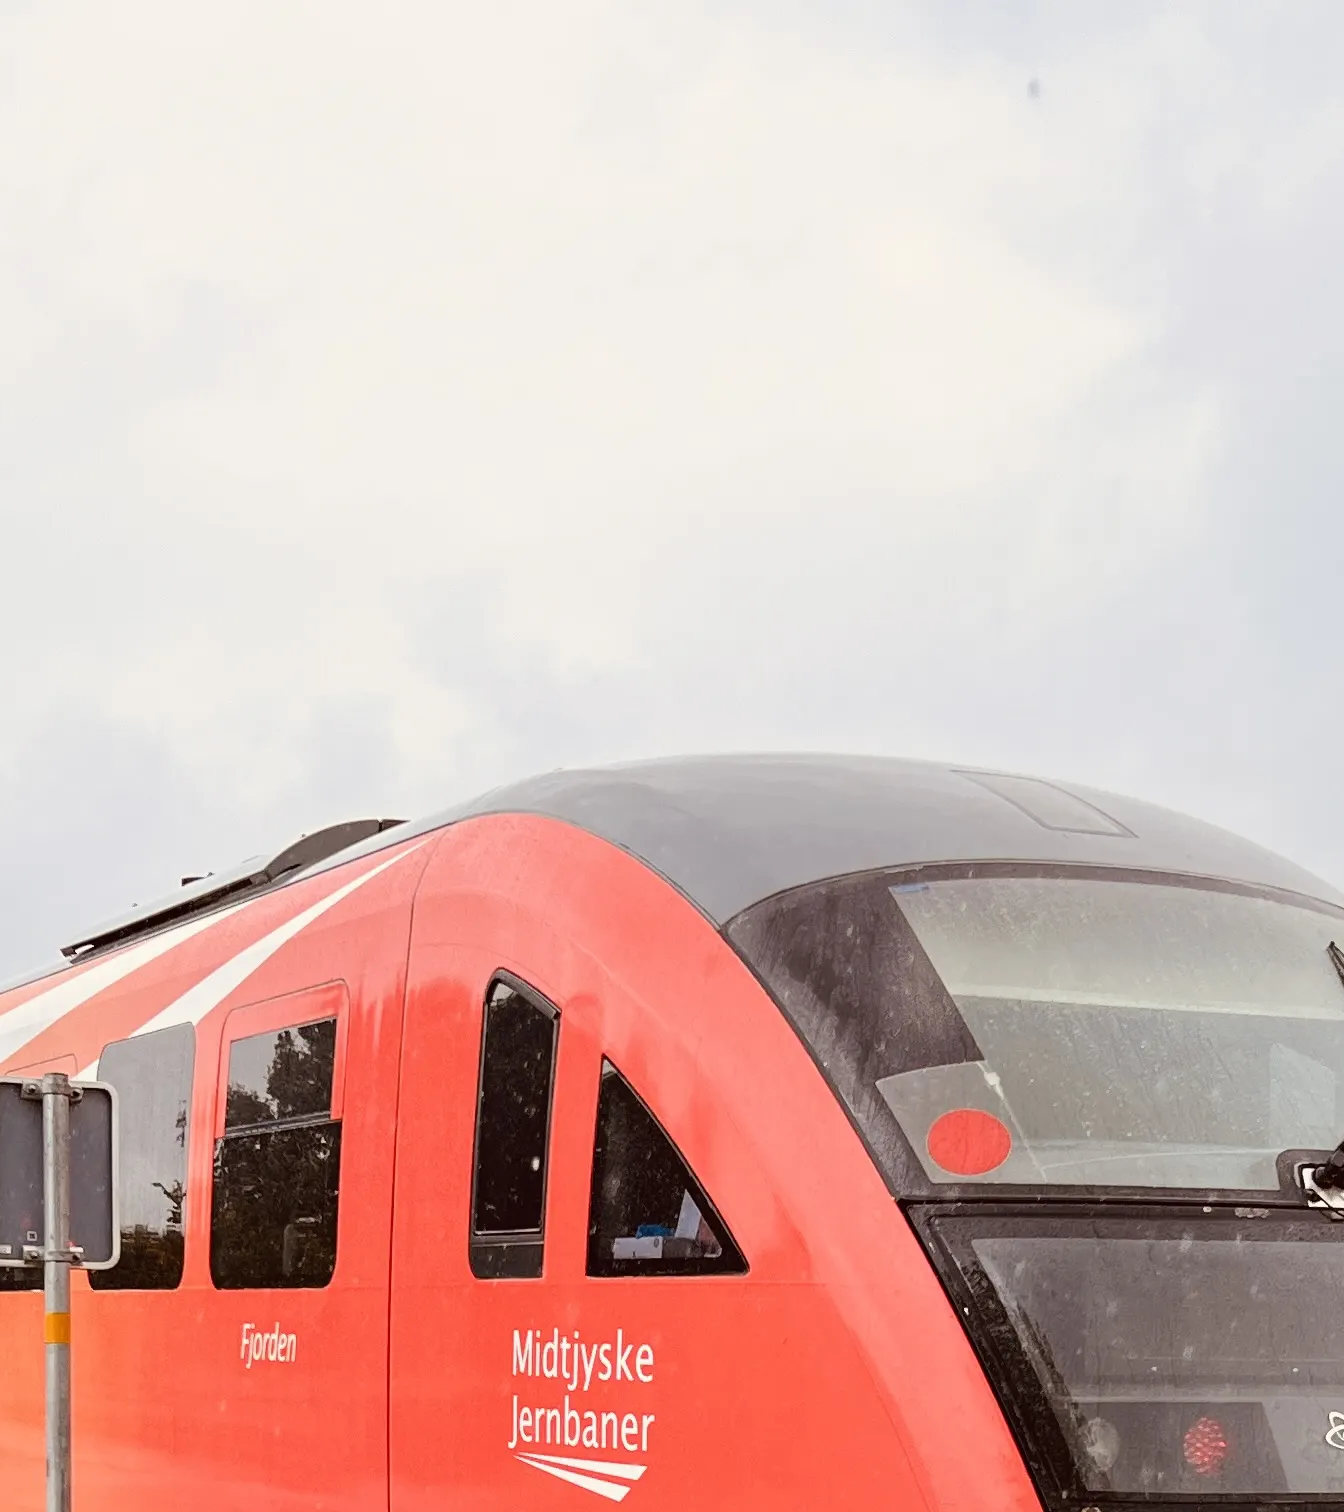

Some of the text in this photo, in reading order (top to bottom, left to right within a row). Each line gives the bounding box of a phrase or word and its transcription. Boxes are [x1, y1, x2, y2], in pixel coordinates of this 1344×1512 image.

[240, 1321, 297, 1369] Fjorden
[512, 1327, 654, 1391] Midtjyske
[508, 1395, 655, 1451] Jernbaner
